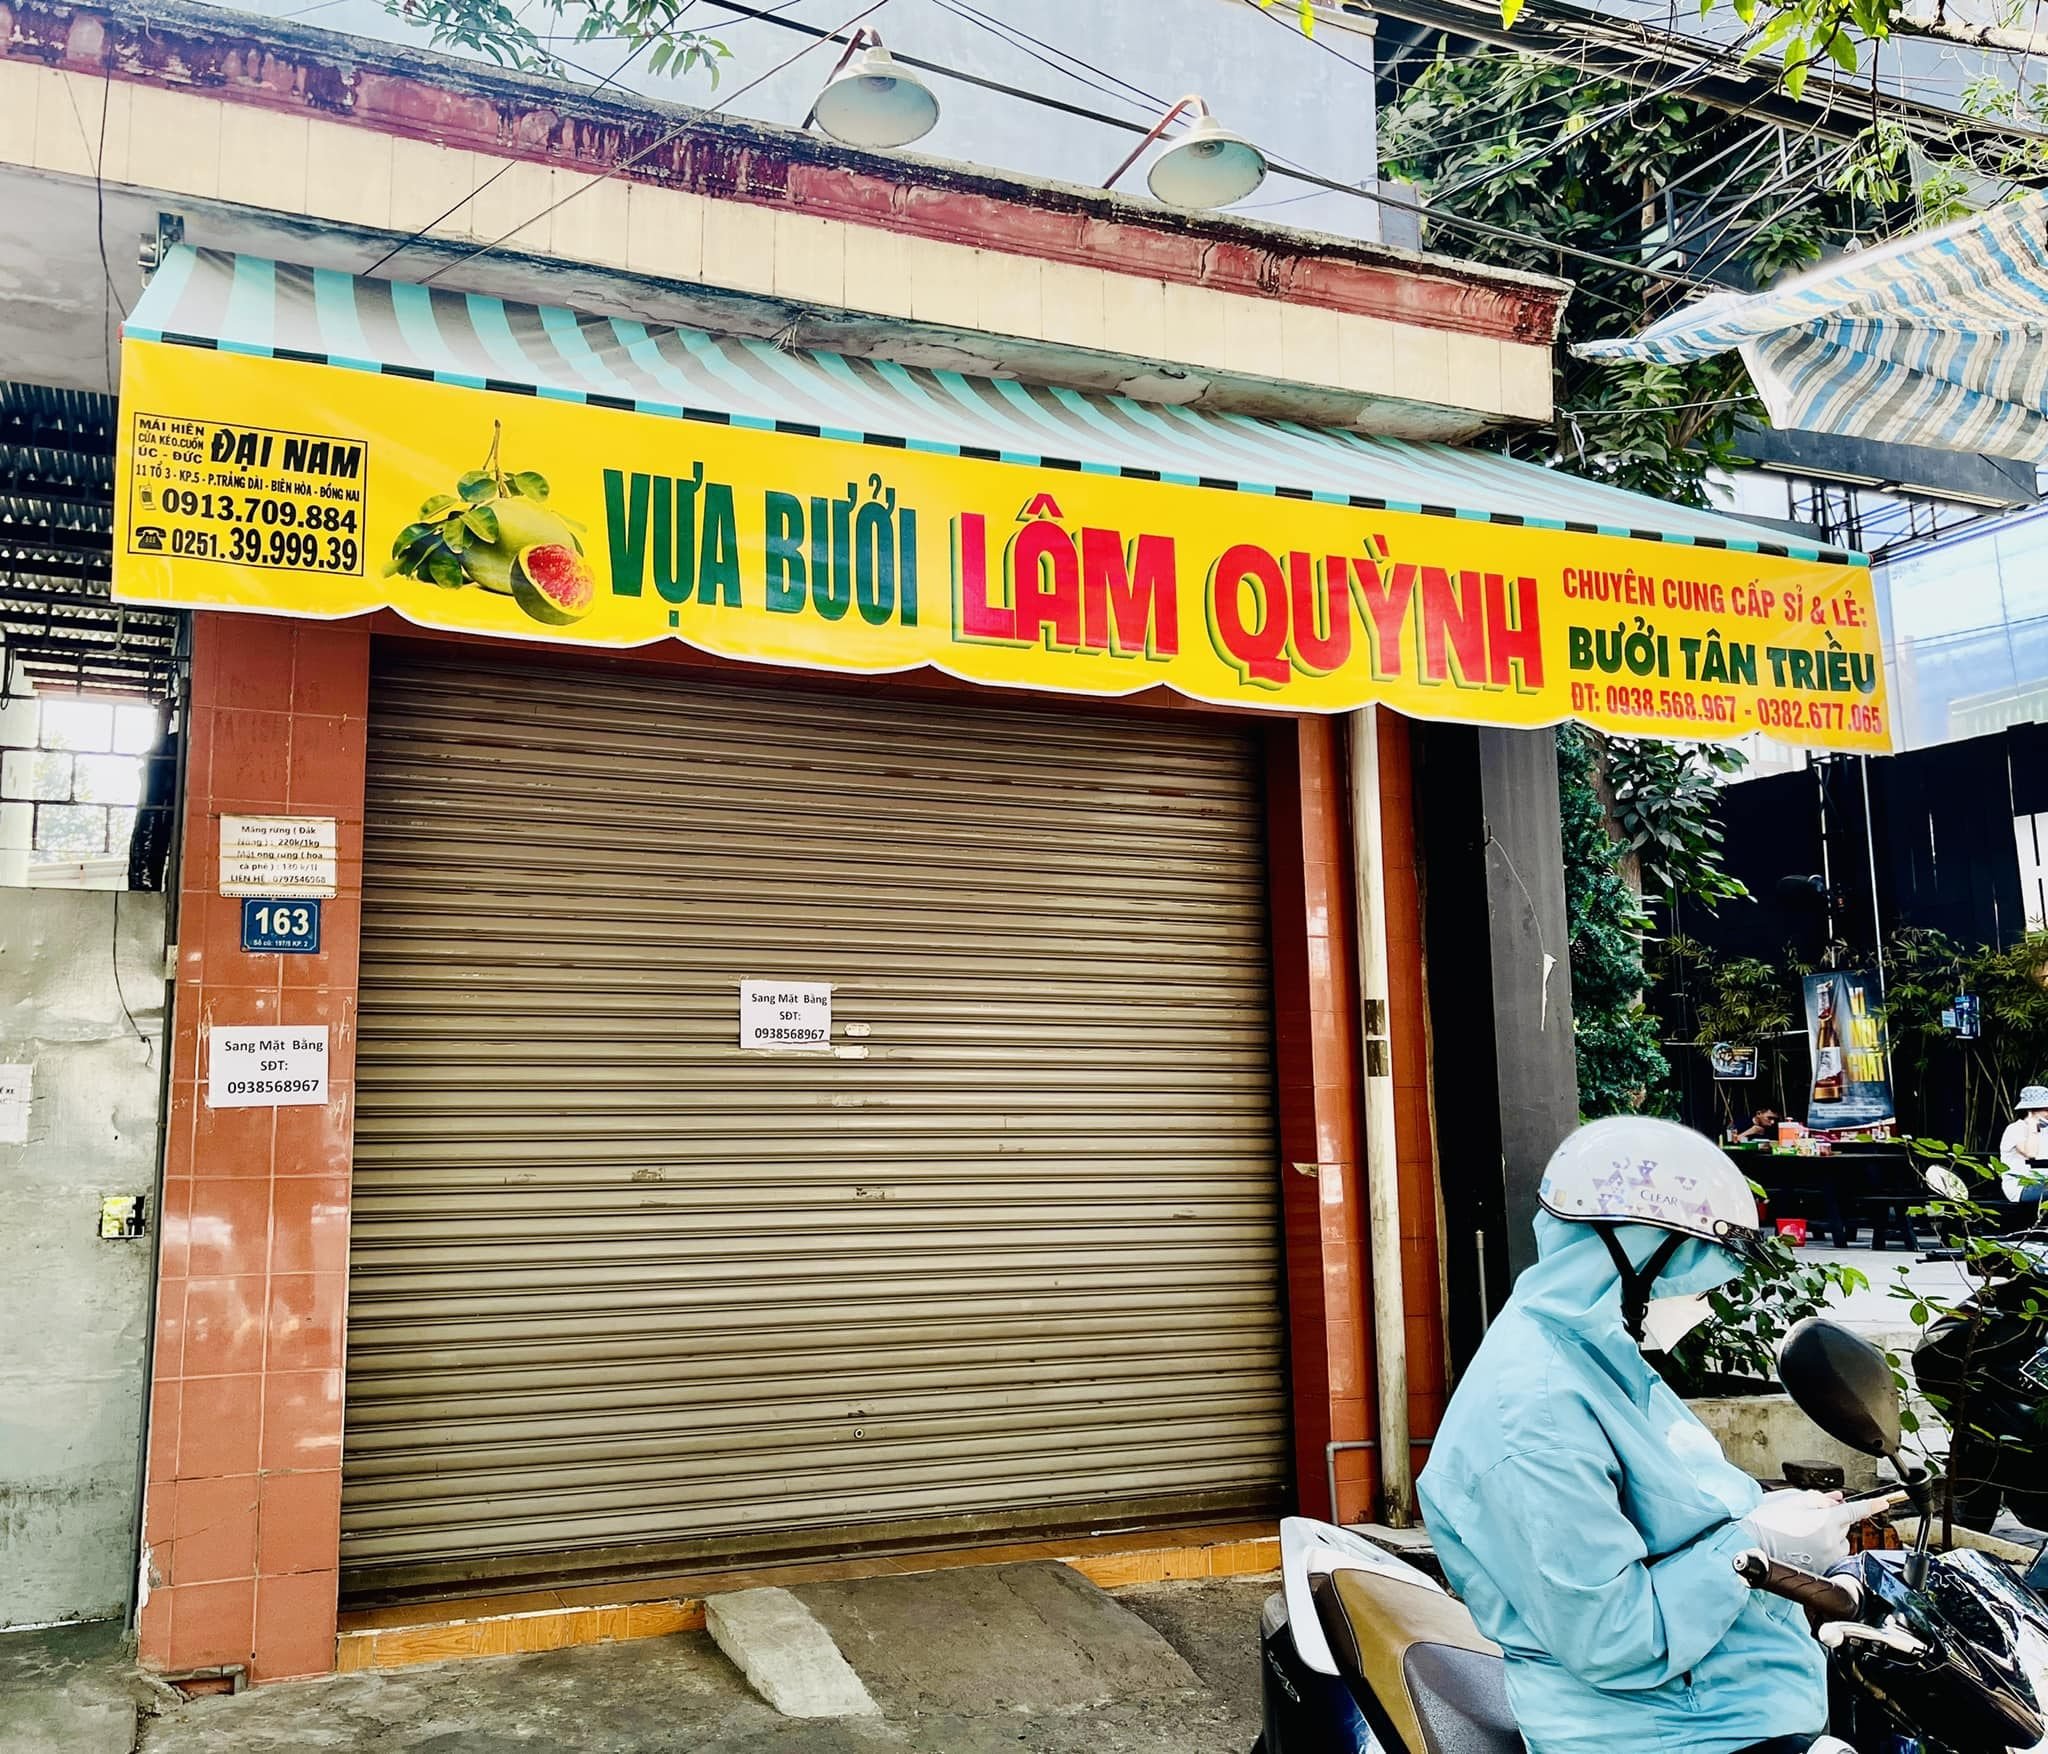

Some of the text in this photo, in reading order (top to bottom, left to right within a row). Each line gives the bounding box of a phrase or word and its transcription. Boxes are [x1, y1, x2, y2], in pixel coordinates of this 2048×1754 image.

[139, 418, 205, 436] MÁI HIÊN
[138, 444, 158, 458] ÚC
[172, 450, 202, 464] ĐỨC
[211, 428, 361, 479] ĐẠI NAM
[136, 463, 146, 476] 11
[165, 467, 171, 479] 3
[271, 478, 292, 494] BIÊN
[294, 480, 312, 496] HÒA
[345, 489, 360, 502] NAI
[162, 488, 358, 534] 0913.709.884
[171, 526, 358, 571] 0251.39.999.39
[603, 461, 1546, 694] VỰA BƯỞI LÂM QUỲNH
[1562, 567, 1867, 628] CHUYÊN CUNG CẤP SỈ & LẺ:
[1568, 615, 1876, 694] BƯỞI TÂN TRIỀU
[1571, 681, 1600, 713] ĐT:
[1606, 685, 1736, 723] 0938.568.967
[1757, 697, 1882, 735] 0382.677.065
[255, 907, 310, 936] 163
[751, 993, 776, 1005] Sang
[779, 1010, 801, 1021] SĐT:
[225, 1037, 324, 1054] Sang Mặt Bằng
[754, 1027, 825, 1040] 0938568967
[260, 1060, 289, 1071] SĐT:
[227, 1080, 320, 1094] 0938568967
